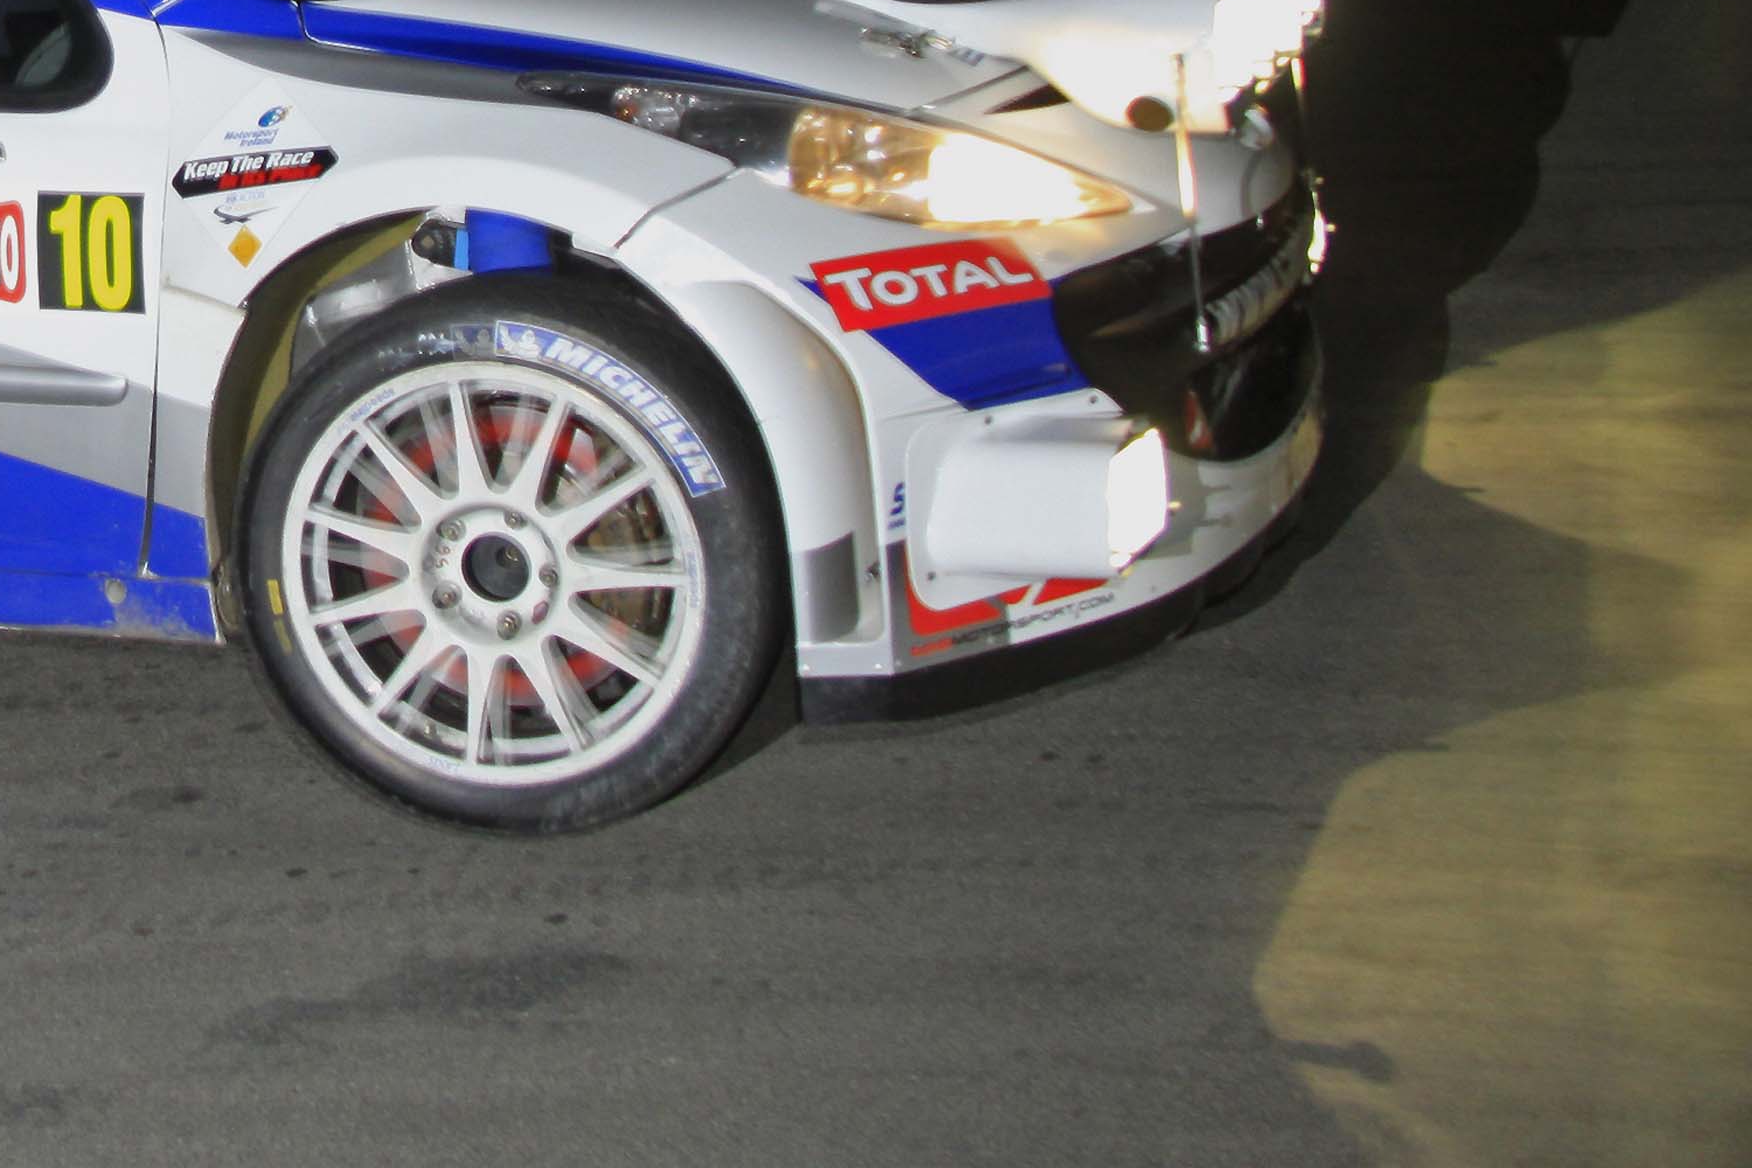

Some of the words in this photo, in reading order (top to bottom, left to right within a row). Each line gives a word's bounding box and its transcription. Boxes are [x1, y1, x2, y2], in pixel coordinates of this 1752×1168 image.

[183, 161, 229, 181] Keep
[230, 155, 263, 174] The
[266, 151, 315, 171] Race
[49, 194, 135, 311] 10
[823, 255, 1035, 312] TOTAL
[547, 338, 722, 494] MICHELIN
